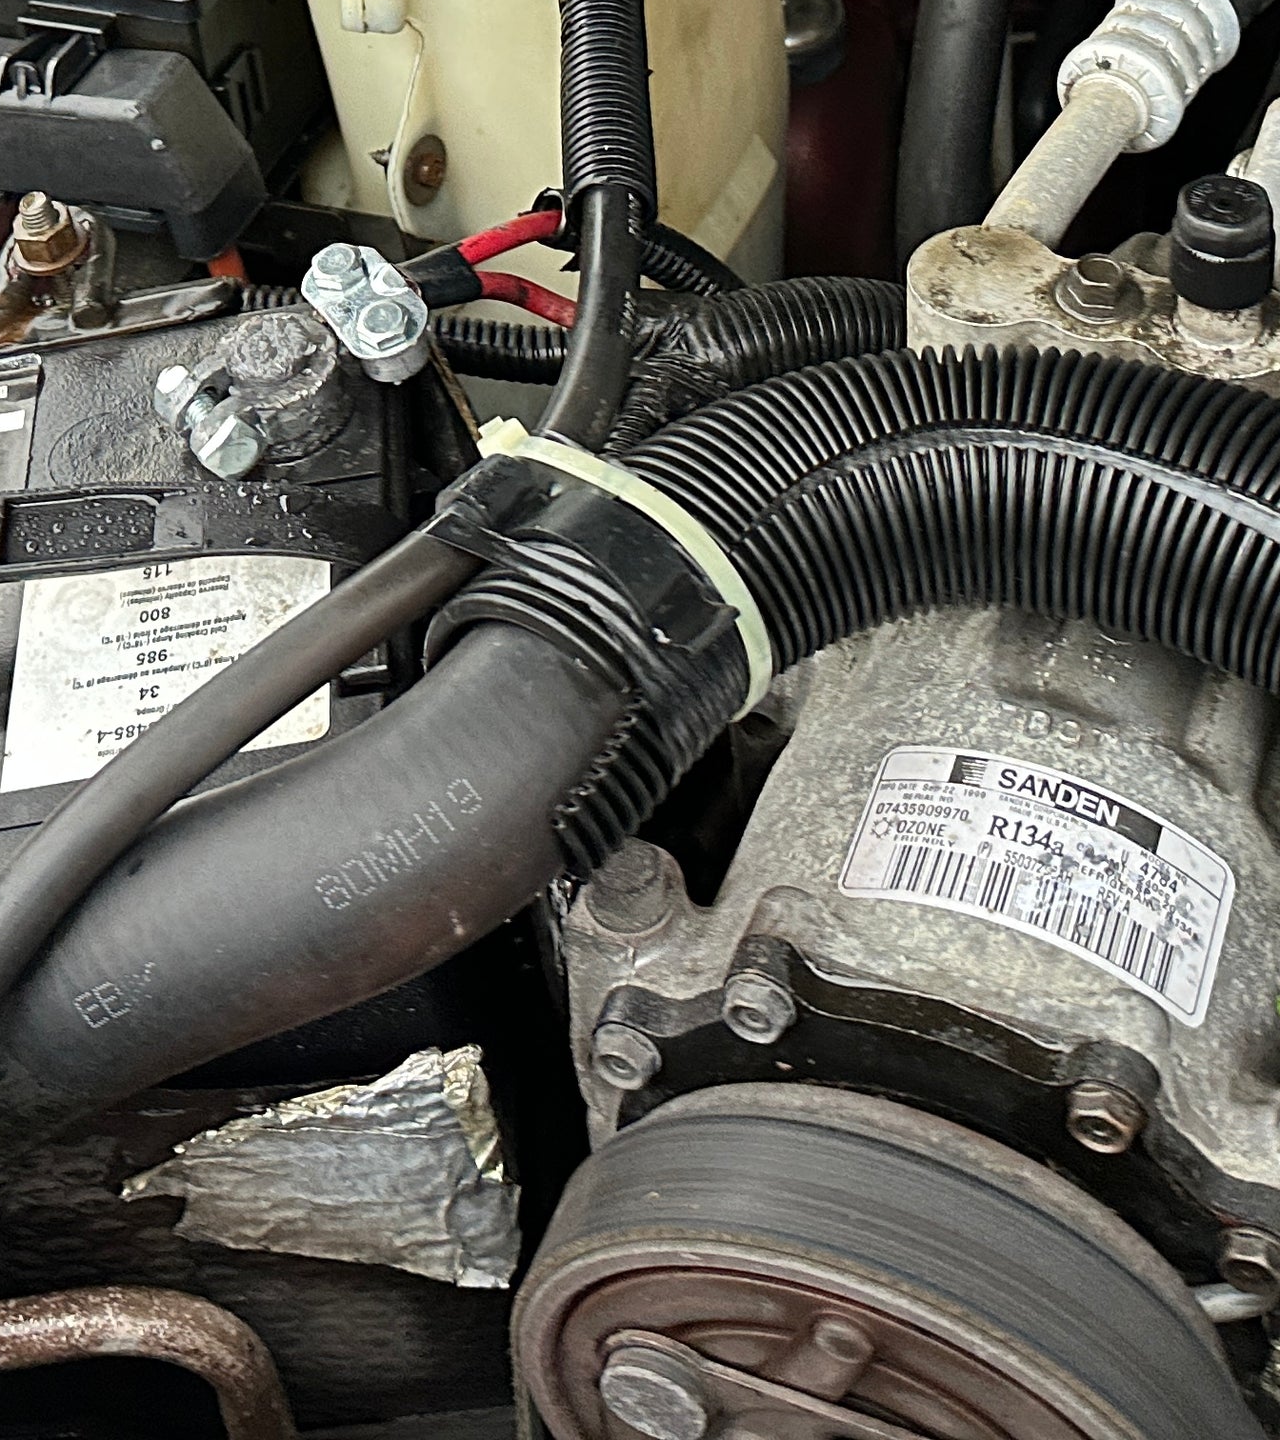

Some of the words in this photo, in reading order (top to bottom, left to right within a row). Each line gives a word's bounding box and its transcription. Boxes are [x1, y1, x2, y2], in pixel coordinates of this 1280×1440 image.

[142, 562, 173, 579] 115
[198, 582, 228, 594] Reserve
[138, 606, 170, 623] 800
[210, 624, 227, 634] Cold
[135, 648, 168, 665] 985
[138, 684, 159, 700] 34
[96, 722, 147, 744] 485-4
[897, 782, 917, 791] DATE
[902, 791, 934, 802] SERIAL
[995, 764, 1122, 827] SANDEN
[875, 798, 970, 825] 07435909970
[895, 818, 947, 838] OZONE
[986, 812, 1069, 858] R134a
[893, 832, 956, 848] FRIENDLY
[976, 839, 993, 858] (P)
[1070, 858, 1161, 913] REFRIGERAN
